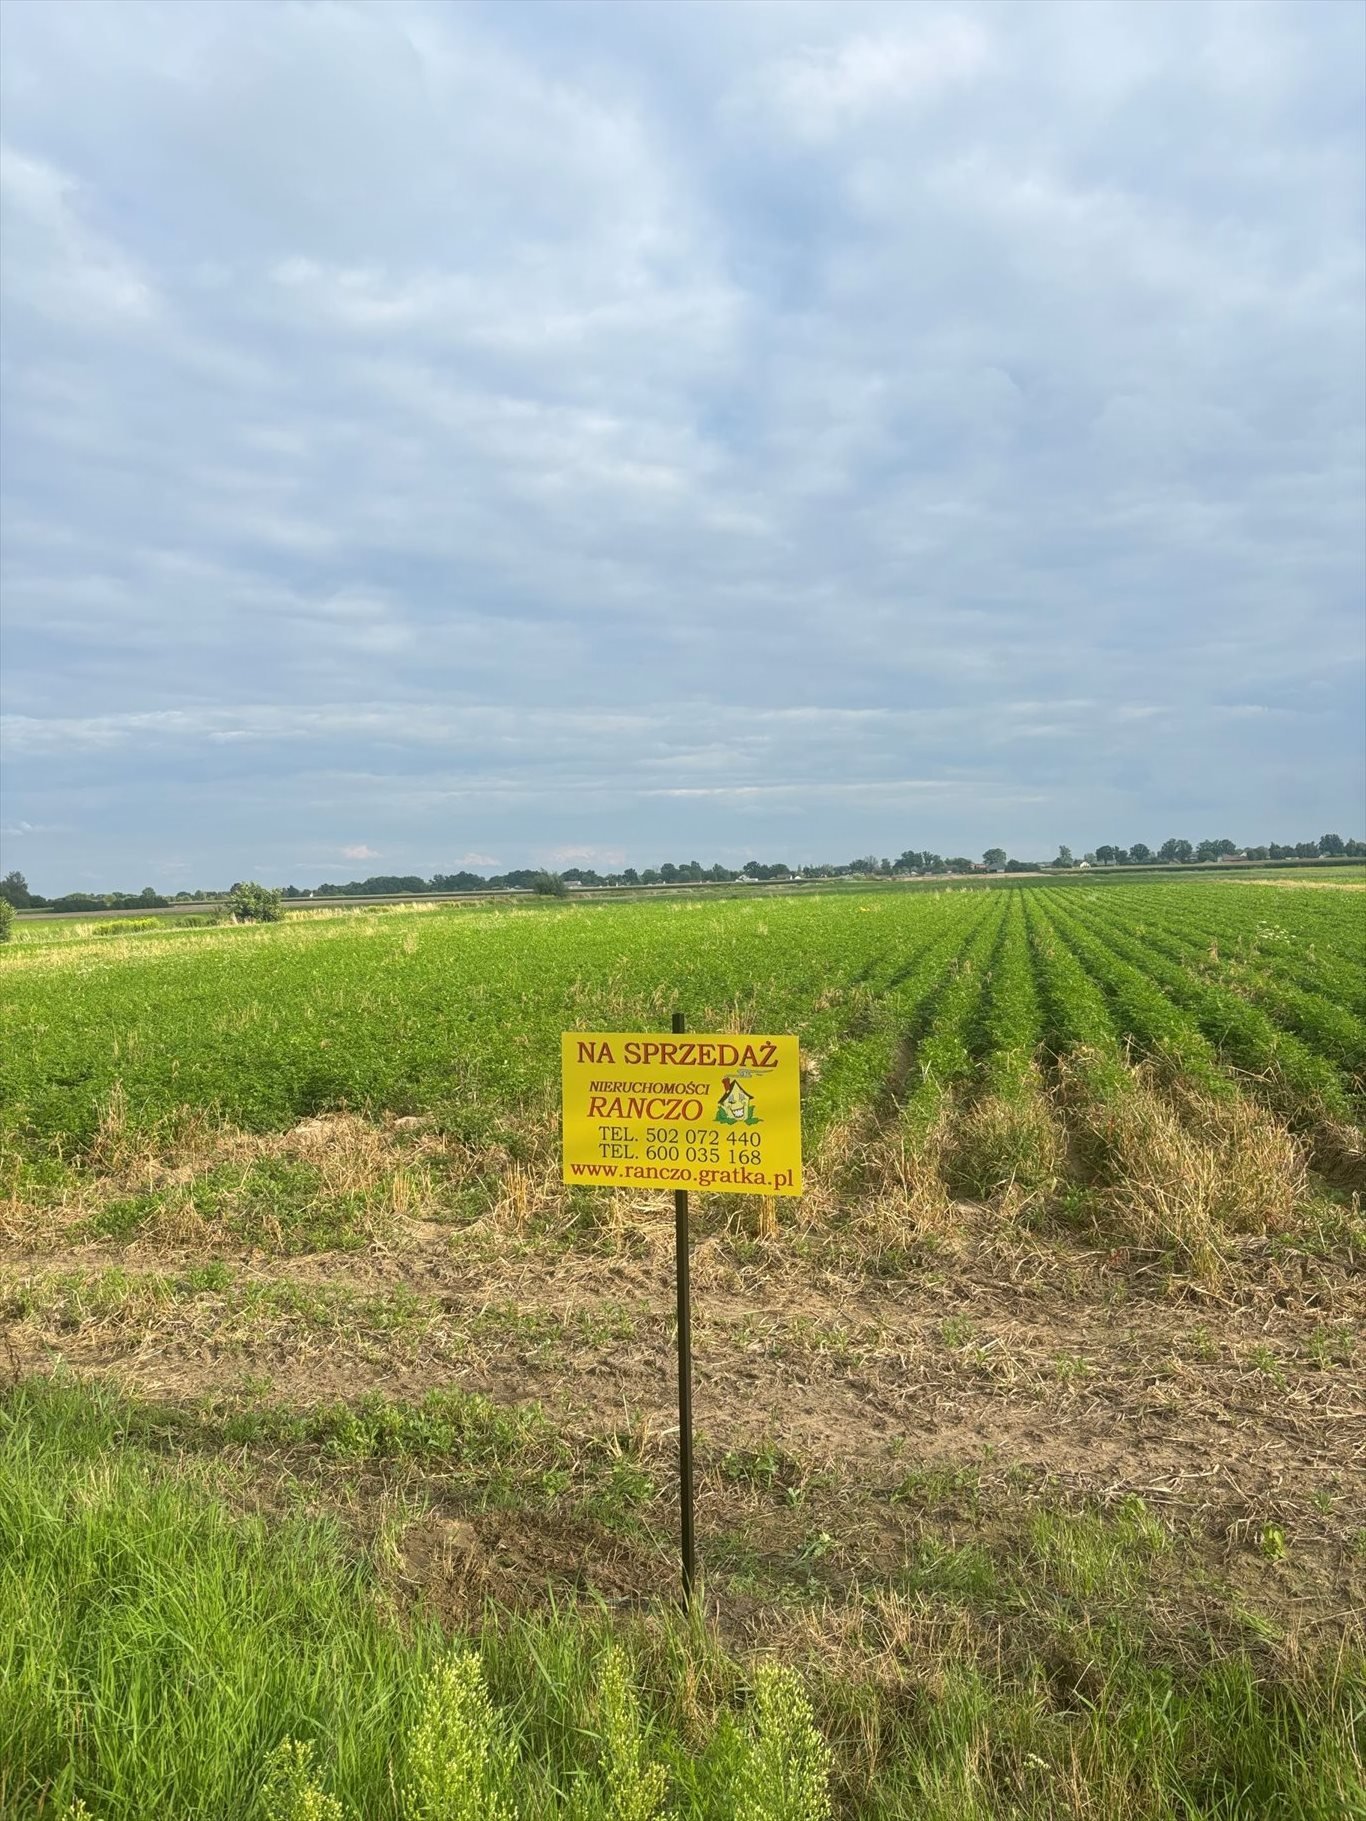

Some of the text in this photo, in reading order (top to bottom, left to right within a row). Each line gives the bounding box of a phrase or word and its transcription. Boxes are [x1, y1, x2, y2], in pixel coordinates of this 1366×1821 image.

[577, 1040, 779, 1068] NA SPRZEDAŻ
[589, 1081, 711, 1096] NIERUCHOMOŚCI
[586, 1096, 704, 1121] RANCZO
[599, 1126, 761, 1147] TEL. 502 072 440
[599, 1143, 761, 1166] TEL. 600 035 168
[570, 1163, 794, 1191] www.ranczo.gratka.pl
